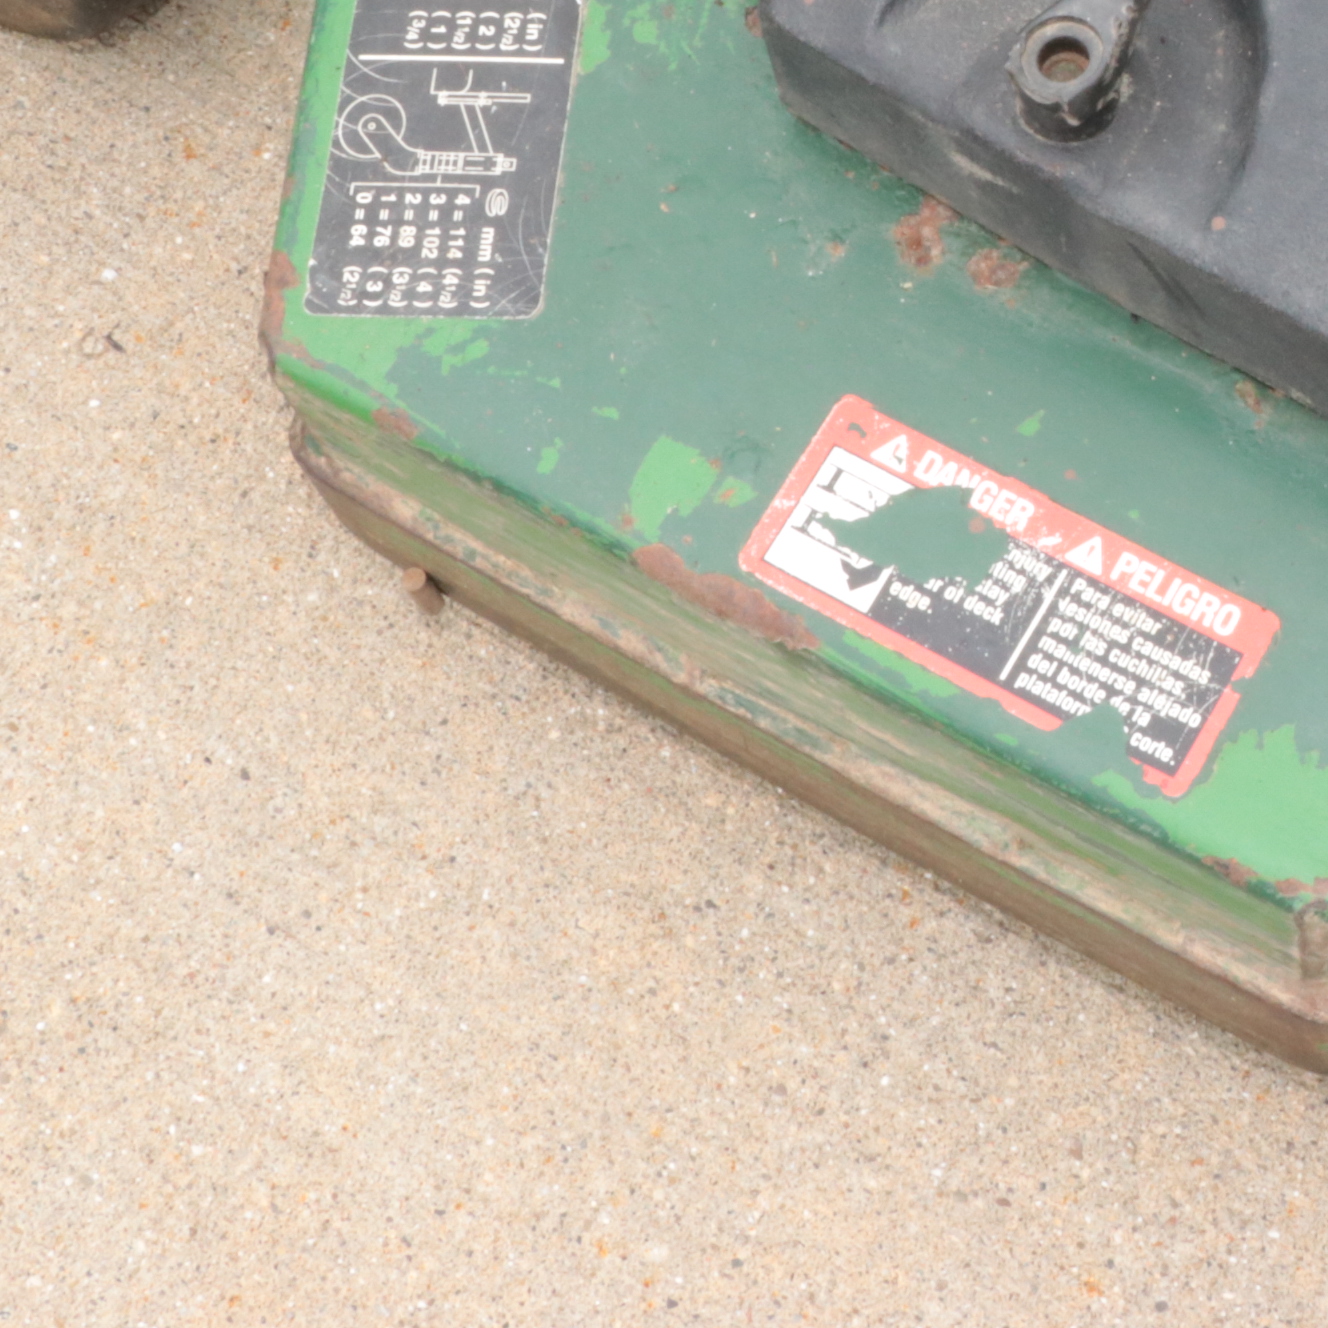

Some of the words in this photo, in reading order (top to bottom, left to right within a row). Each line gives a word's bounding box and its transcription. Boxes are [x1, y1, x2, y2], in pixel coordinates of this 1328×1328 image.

[356, 192, 372, 204] 0
[381, 194, 397, 202] 1
[405, 193, 422, 204] 2
[429, 194, 447, 205] 3
[455, 194, 471, 205] 4
[355, 208, 365, 220] =
[379, 209, 389, 220] =
[404, 209, 414, 221] =
[428, 210, 438, 221] =
[453, 210, 463, 221] =
[349, 224, 367, 246] 64
[373, 225, 392, 247] 76
[398, 225, 417, 248] 89
[421, 227, 441, 259] 102
[446, 227, 466, 259] 114
[477, 227, 495, 262] mm
[913, 450, 1035, 532] DANGER
[888, 577, 932, 614] edge.
[943, 585, 965, 604] of
[962, 594, 1004, 626] deck
[1109, 551, 1241, 636] PELIGRO
[1069, 577, 1111, 611] Para
[1111, 602, 1164, 635] evitar
[1046, 616, 1079, 641] por
[1131, 636, 1211, 685] causadas
[1026, 652, 1058, 678] del
[1055, 665, 1107, 704] borde
[1131, 704, 1151, 727] la
[1136, 686, 1201, 728] alejado
[1129, 731, 1175, 766] corte.
